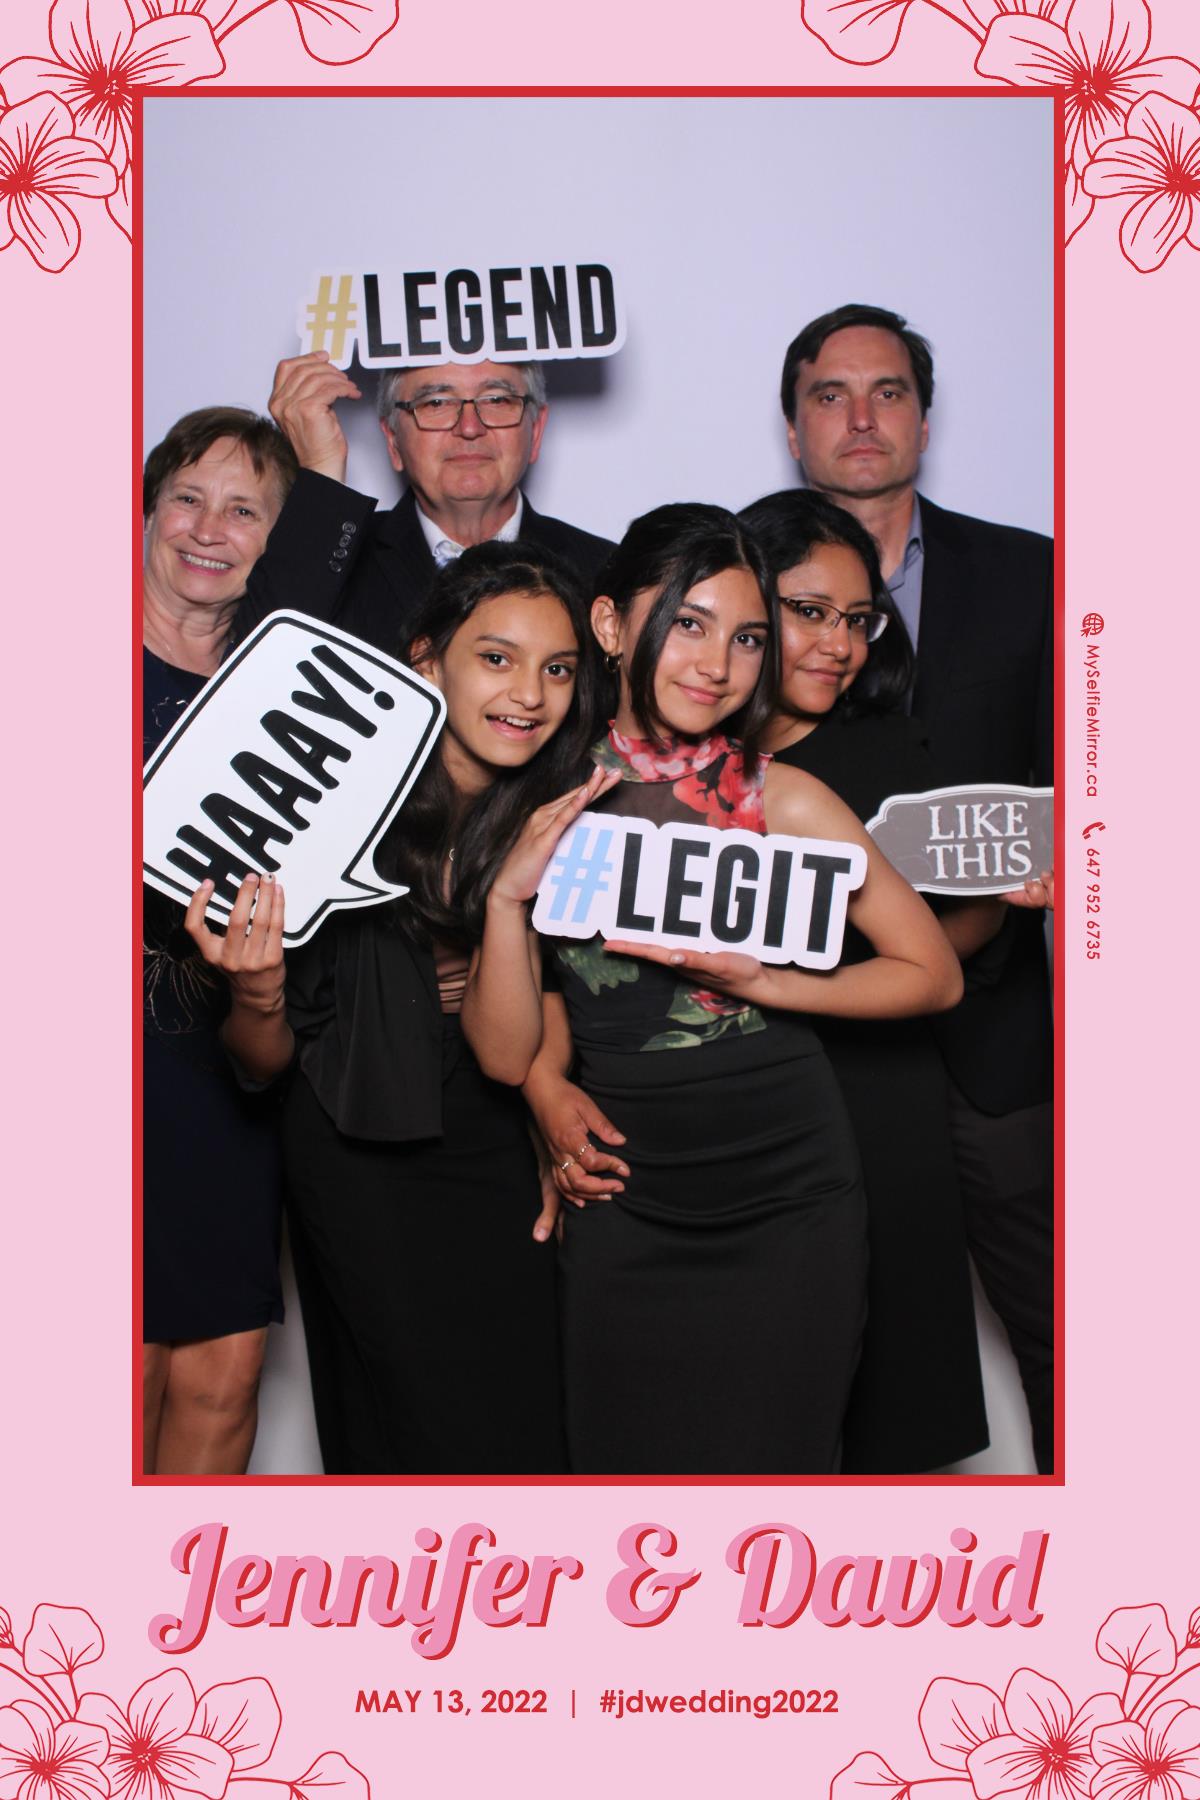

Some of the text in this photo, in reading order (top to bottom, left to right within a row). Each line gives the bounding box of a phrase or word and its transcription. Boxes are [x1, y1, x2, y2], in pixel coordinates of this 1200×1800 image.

[306, 264, 617, 361] #LEGEND
[166, 644, 395, 906] HAAAY!
[928, 801, 1029, 841] LIKE
[548, 826, 852, 954] #LEGIT
[926, 840, 1033, 880] THIS
